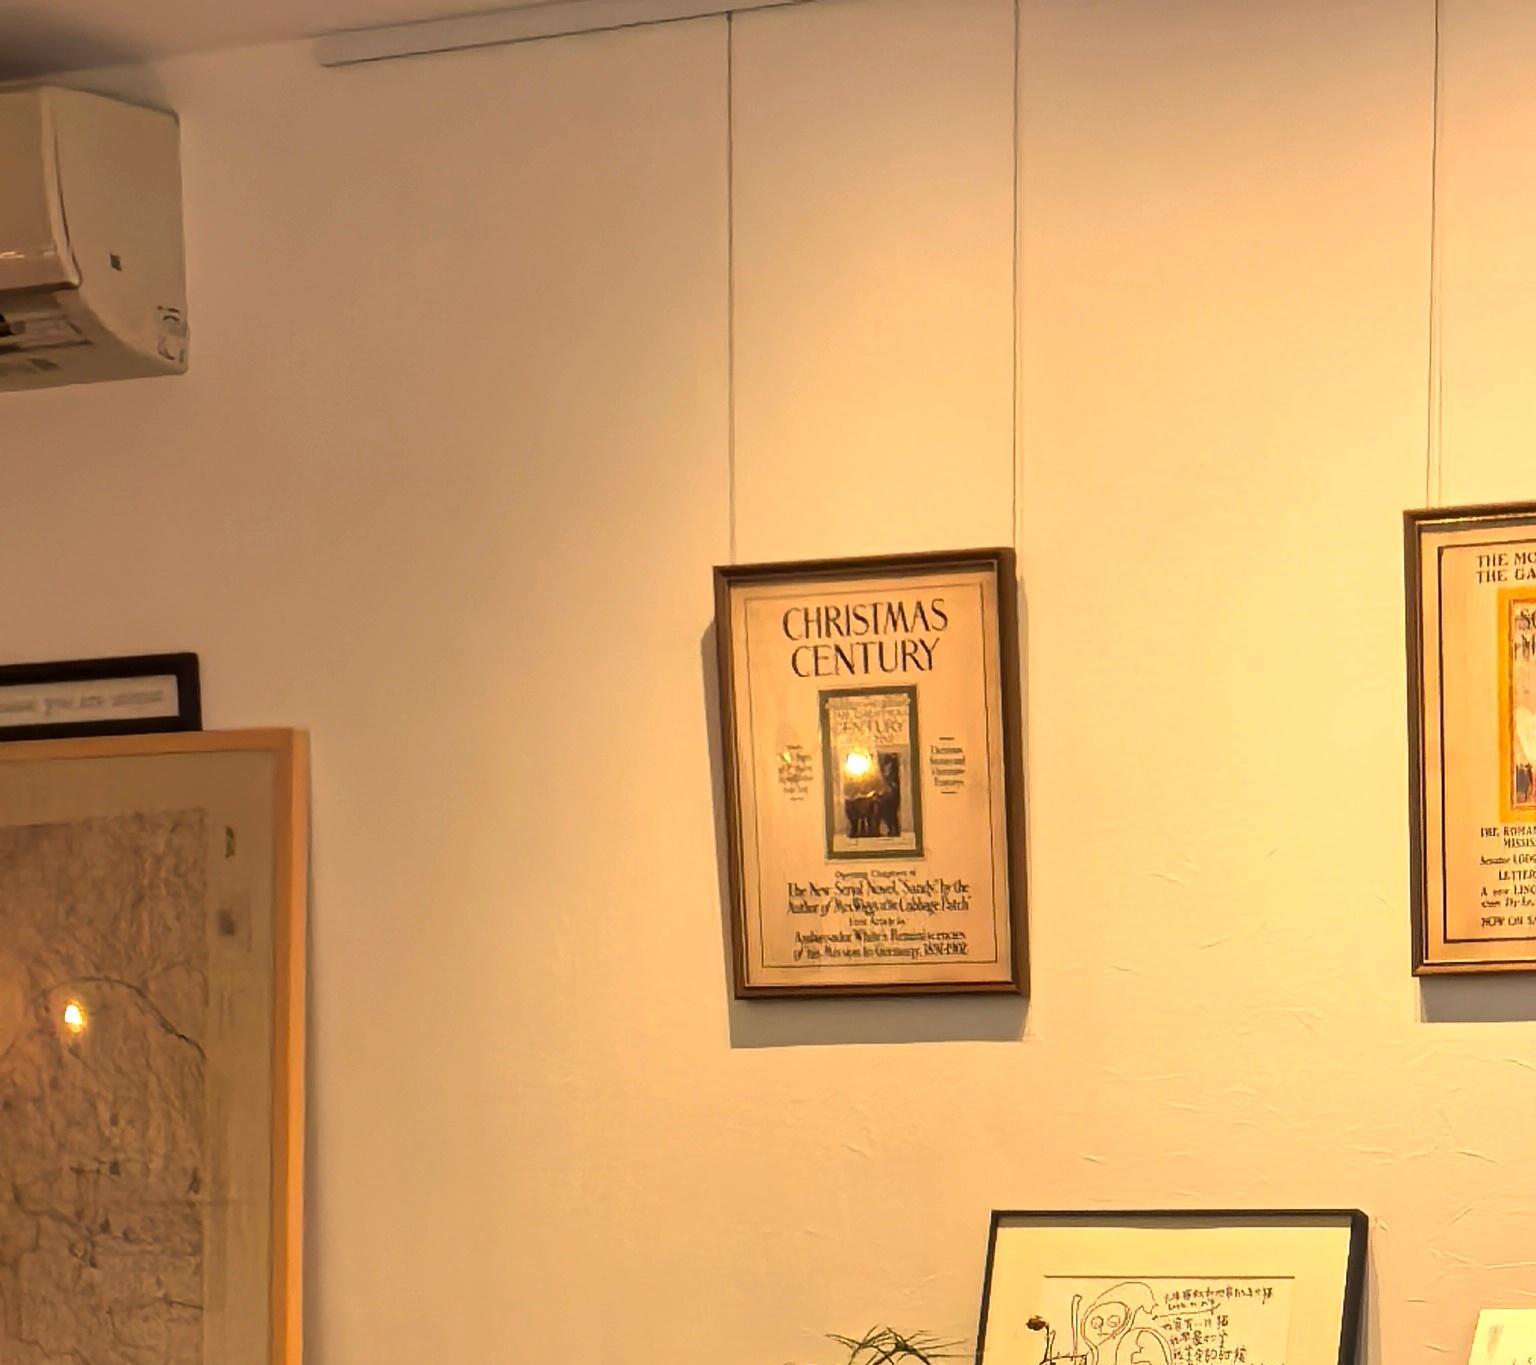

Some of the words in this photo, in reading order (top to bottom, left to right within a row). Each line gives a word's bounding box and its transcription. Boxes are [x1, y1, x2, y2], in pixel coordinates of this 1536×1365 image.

[1476, 553, 1509, 568] THE
[1476, 569, 1508, 584] THE
[782, 598, 948, 641] CHRISTMAS
[791, 638, 941, 678] CENTURY
